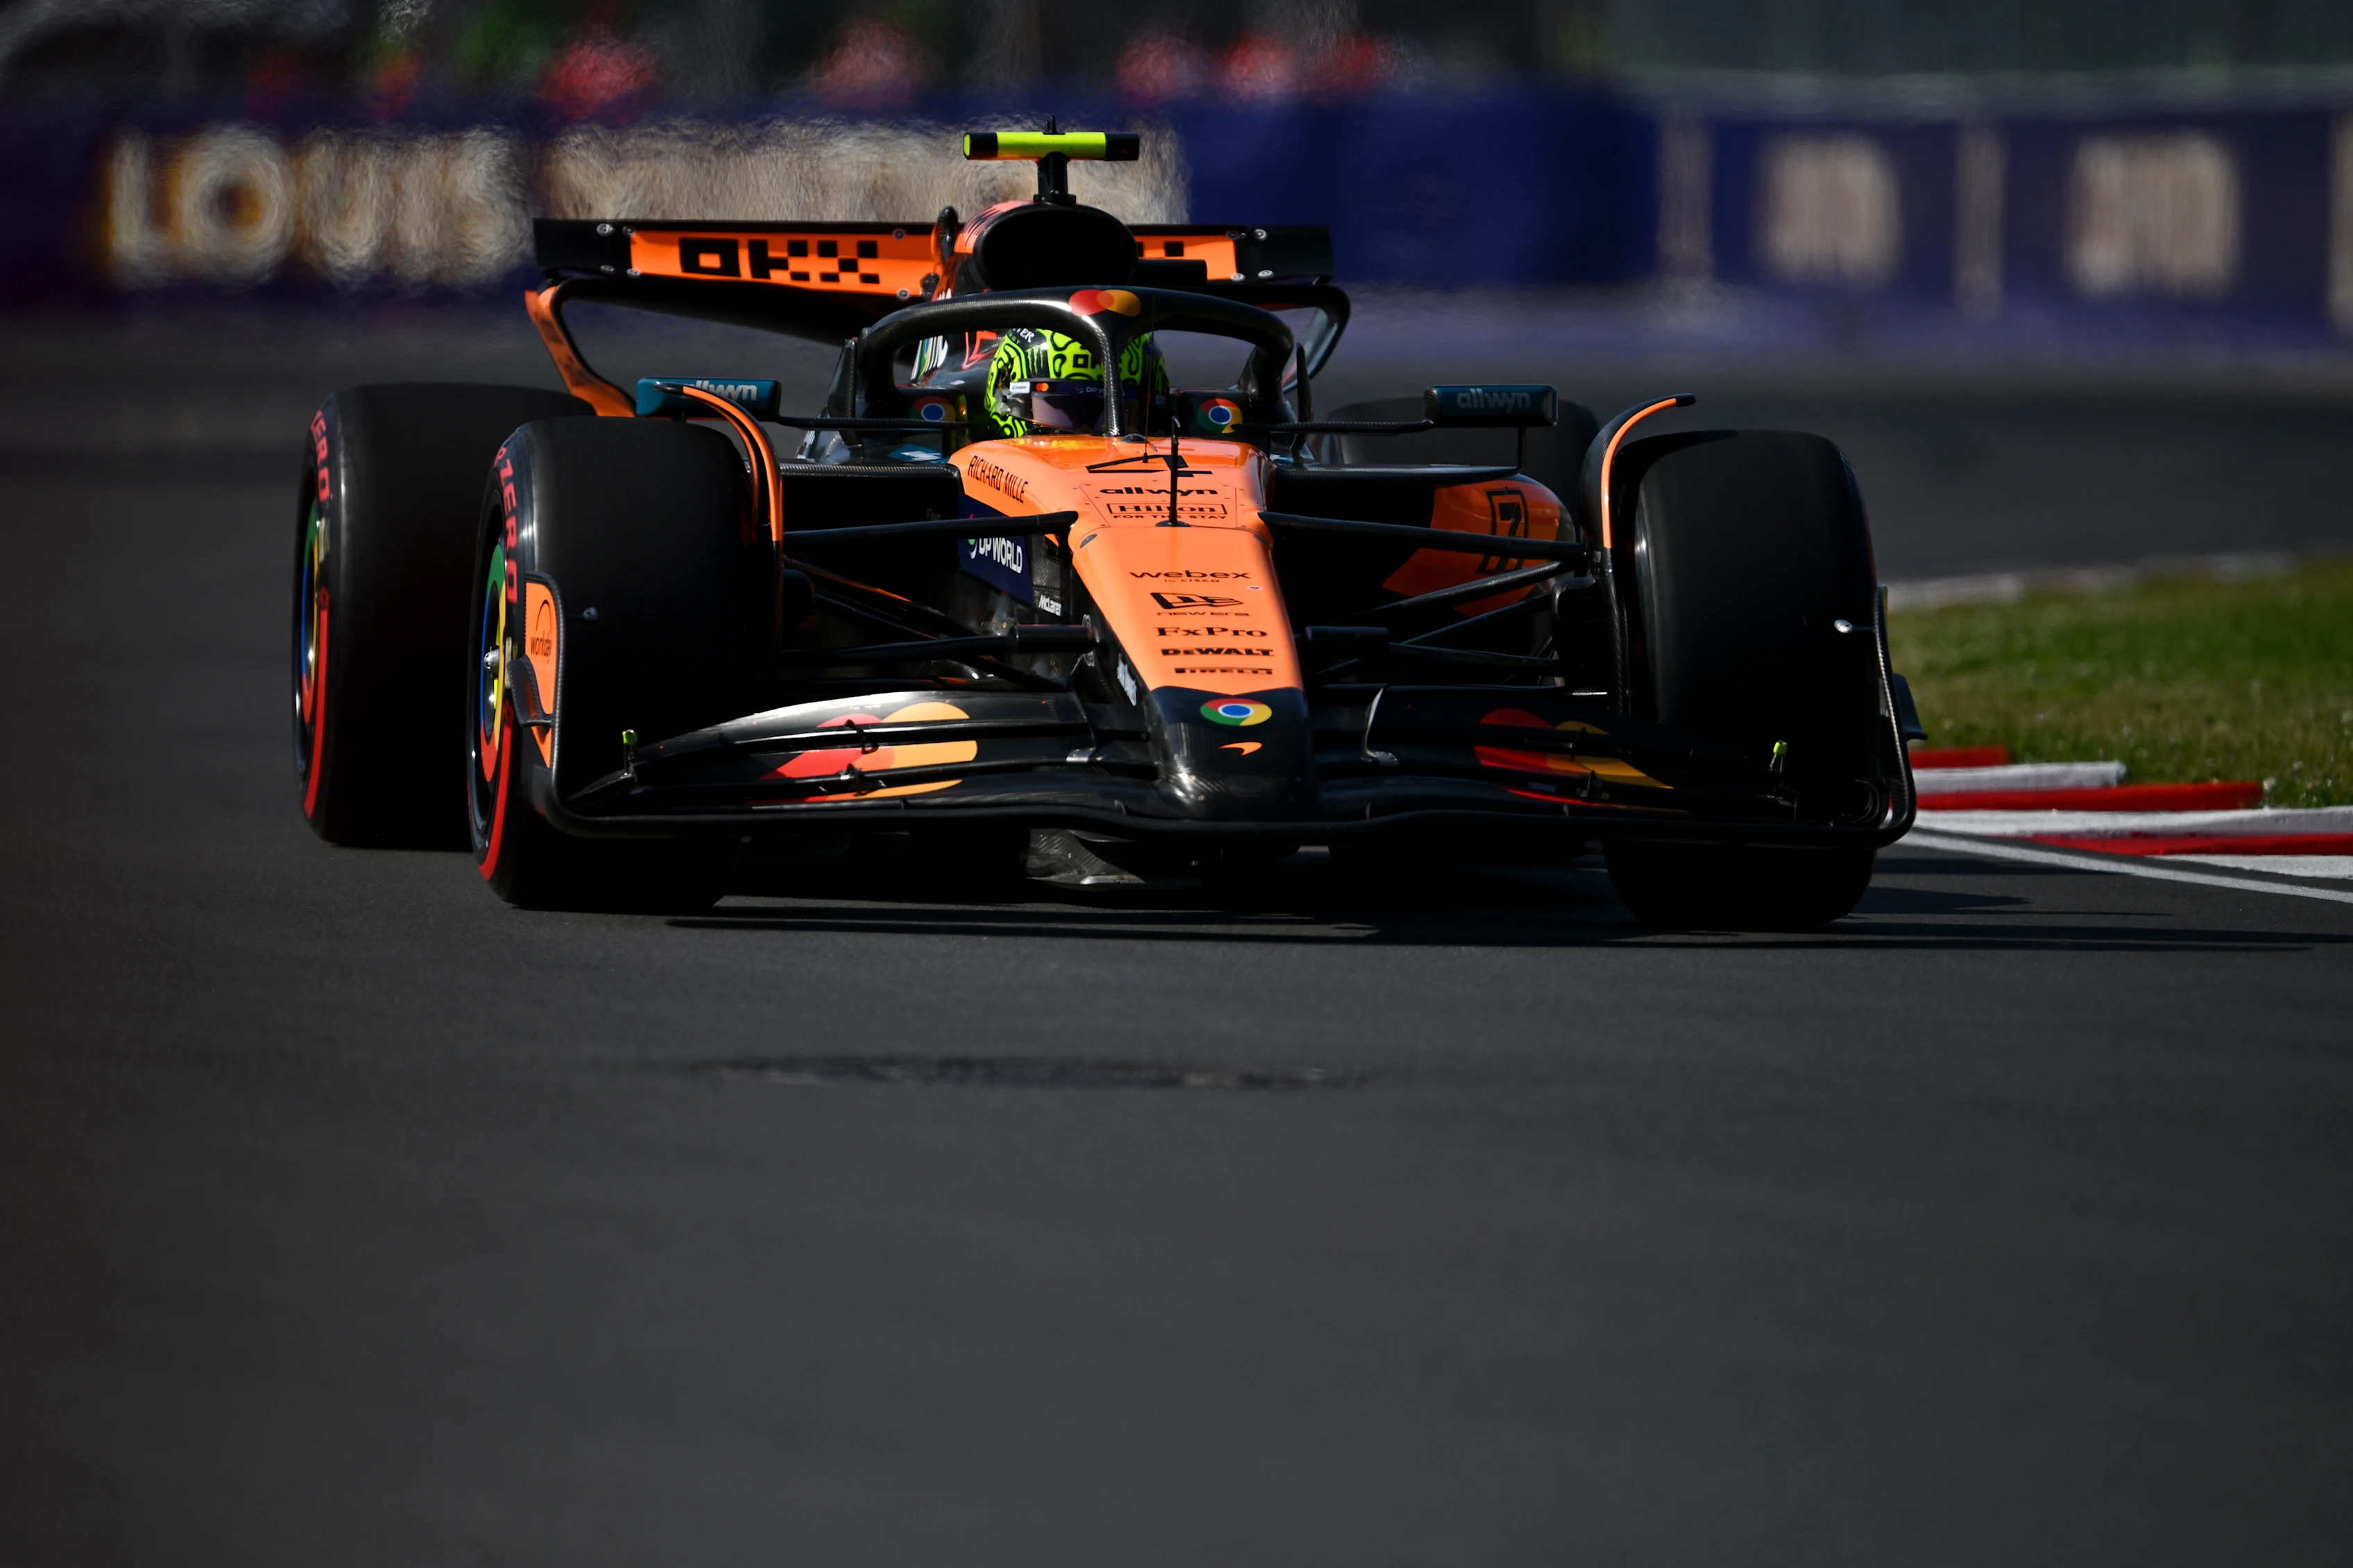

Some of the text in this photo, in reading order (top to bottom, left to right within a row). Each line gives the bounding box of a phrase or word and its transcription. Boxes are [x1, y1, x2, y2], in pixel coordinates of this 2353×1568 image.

[678, 237, 880, 284] OKX
[683, 380, 758, 402] lwyn
[1457, 388, 1531, 414] allwyn
[968, 455, 1028, 503] RICHARD MILLE
[1100, 487, 1218, 497] allwyn
[499, 458, 518, 603] ZERO
[992, 537, 1023, 574] WORLD
[1129, 570, 1251, 578] webex
[1155, 627, 1267, 637] FxPro
